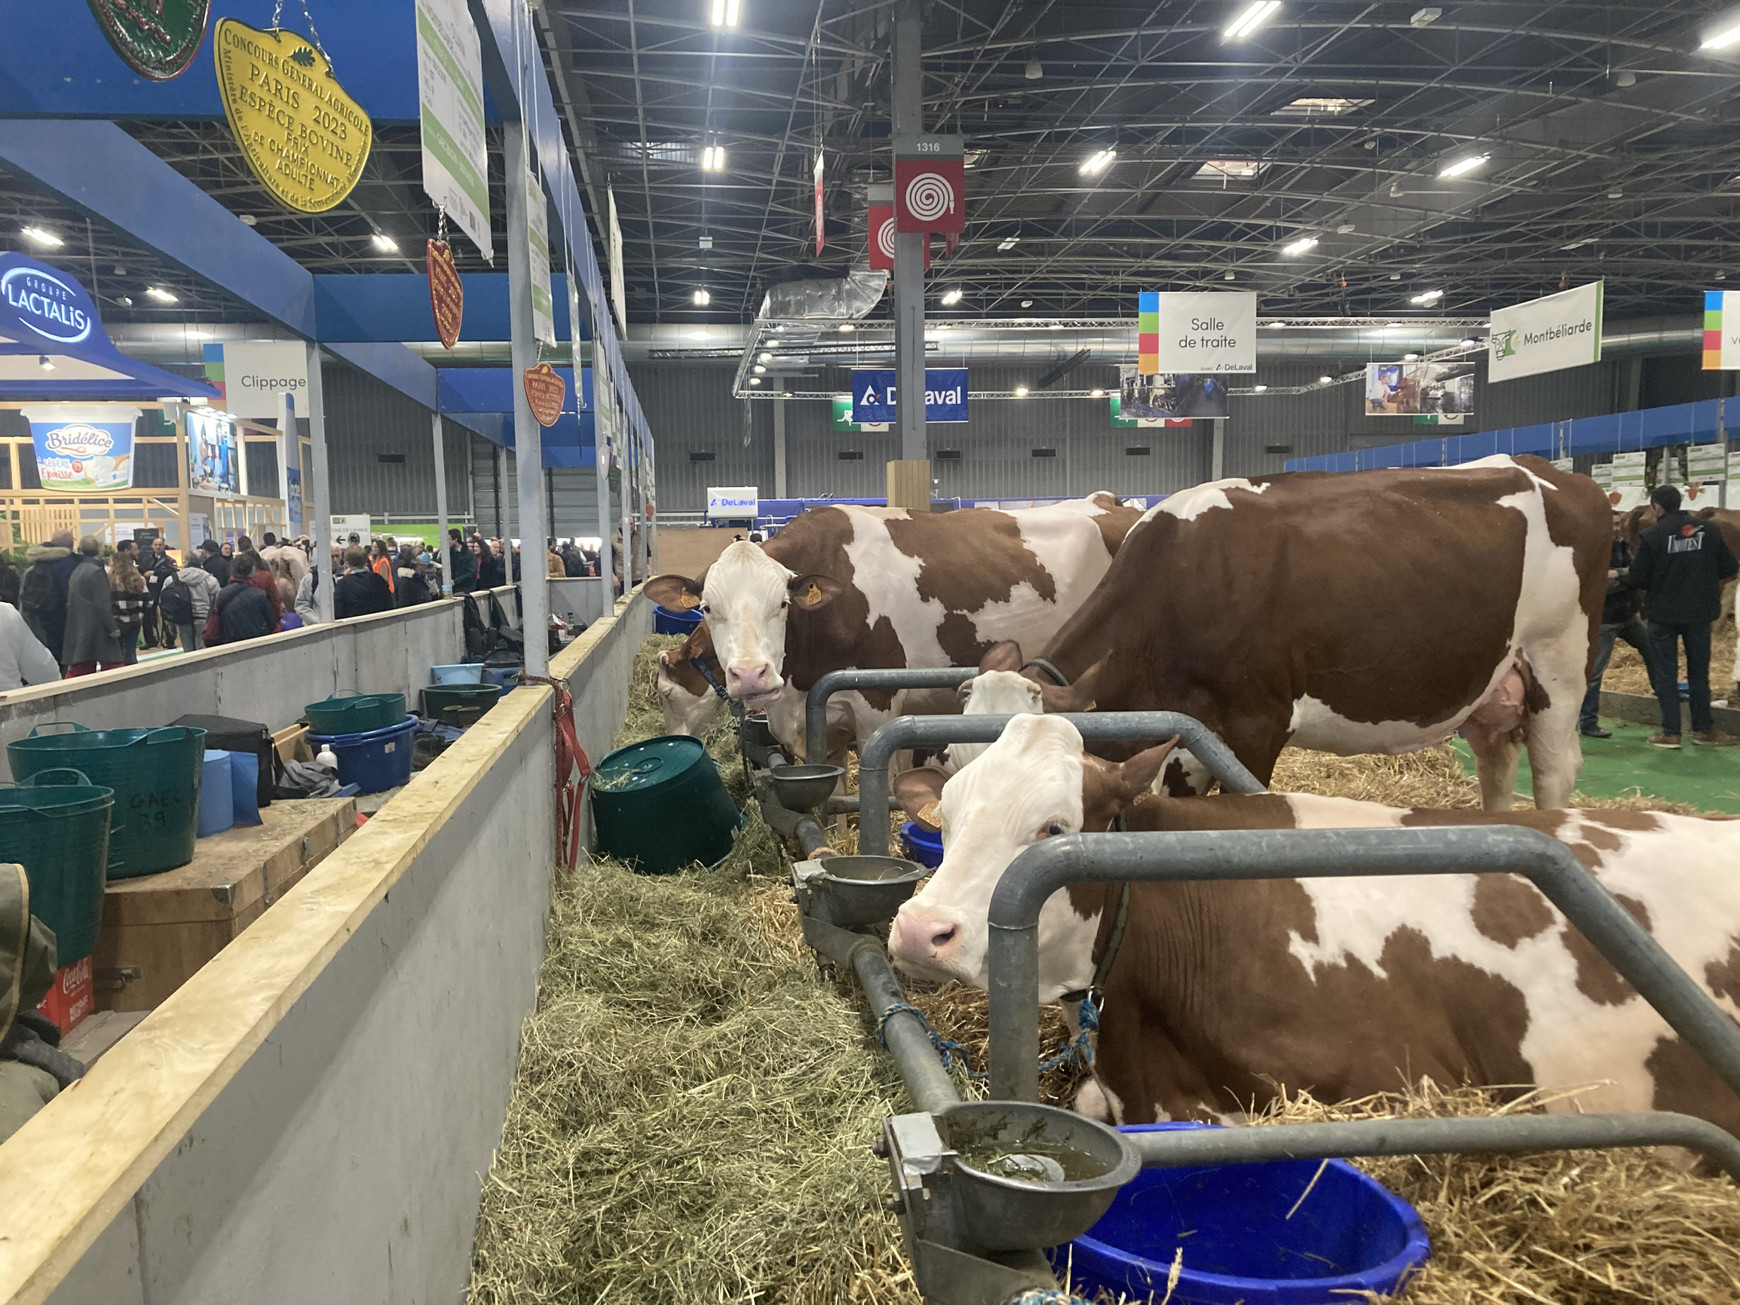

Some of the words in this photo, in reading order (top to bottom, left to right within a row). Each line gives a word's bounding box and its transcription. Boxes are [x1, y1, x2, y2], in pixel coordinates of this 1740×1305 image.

[224, 28, 279, 69] CONCOURS
[282, 59, 324, 100] GENERAL
[325, 90, 369, 137] AGRICOLE
[249, 62, 300, 109] PARIS
[312, 105, 347, 140] 2023
[235, 108, 244, 121] de
[238, 84, 295, 132] ESPÈCE
[298, 122, 353, 168] BOVINE
[285, 131, 309, 156] PRIX
[916, 142, 940, 152] 1316
[253, 131, 265, 146] DE
[268, 139, 340, 189] CHAMPIONNAT
[275, 159, 315, 191] ADULTE
[26, 276, 67, 300] GROUPE
[1191, 317, 1225, 331] Salle
[1523, 318, 1592, 346] Montbéliarde
[1178, 335, 1197, 348] de
[1200, 335, 1237, 348] traite
[1224, 363, 1253, 371] DeLaval
[241, 374, 306, 391] Clippage
[886, 386, 962, 405] Daval
[47, 432, 113, 449] Bridélice
[721, 498, 756, 506] DeLaval
